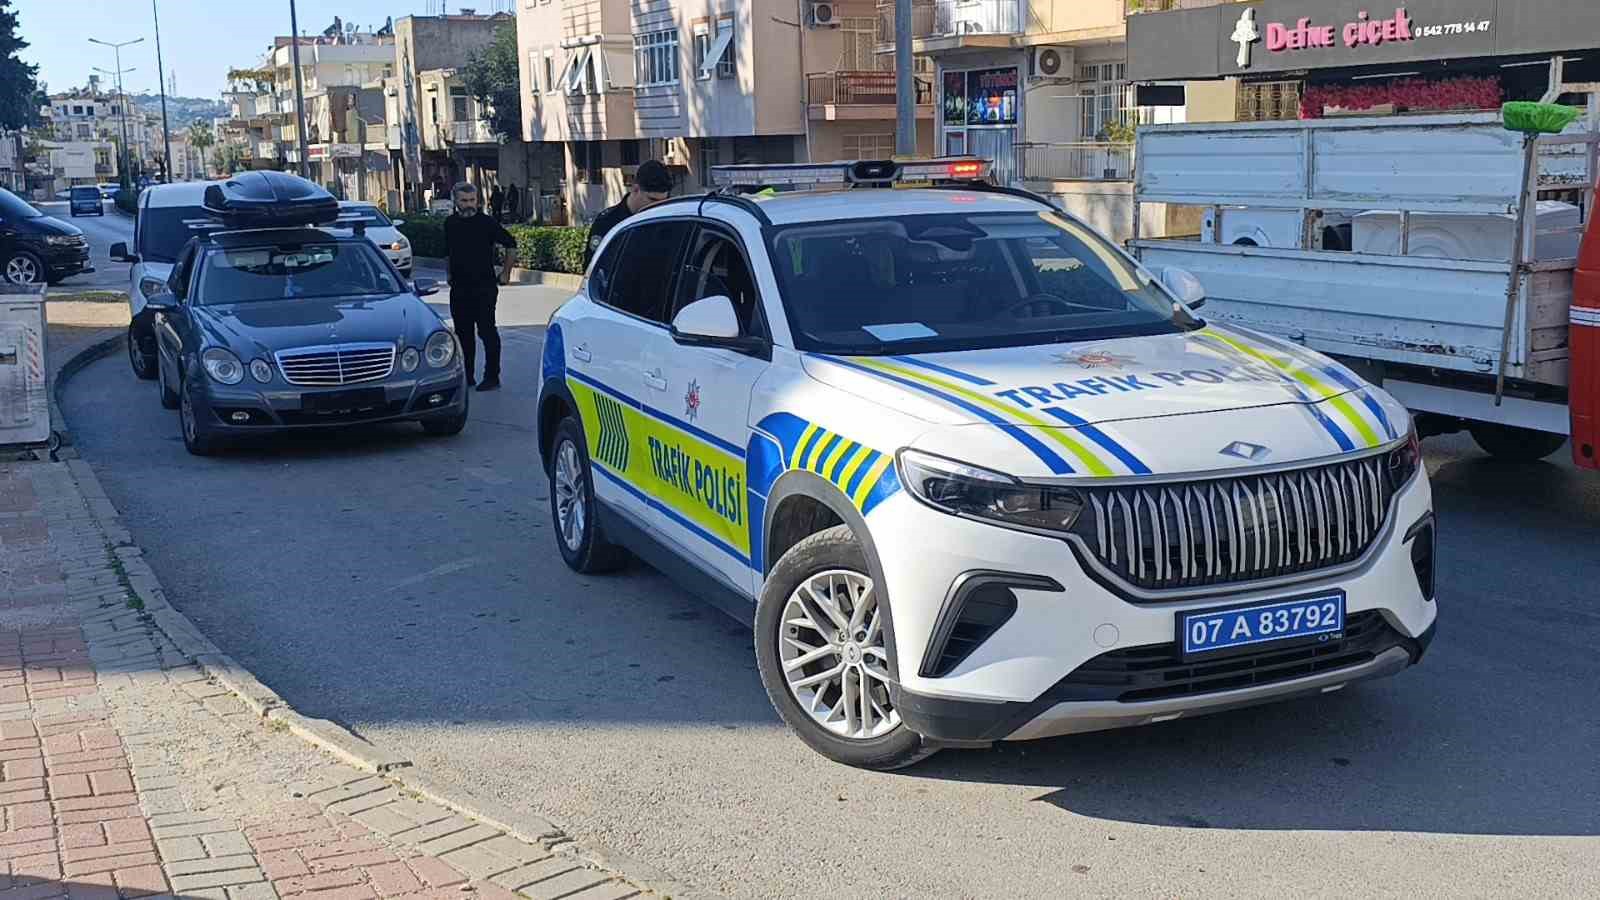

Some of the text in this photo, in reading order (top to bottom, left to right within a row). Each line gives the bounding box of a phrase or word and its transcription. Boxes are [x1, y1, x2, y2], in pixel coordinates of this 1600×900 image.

[1423, 25, 1442, 36] 542
[648, 436, 742, 526] TRAFİK POLİSİ
[1192, 603, 1337, 645] 07 A 83792
